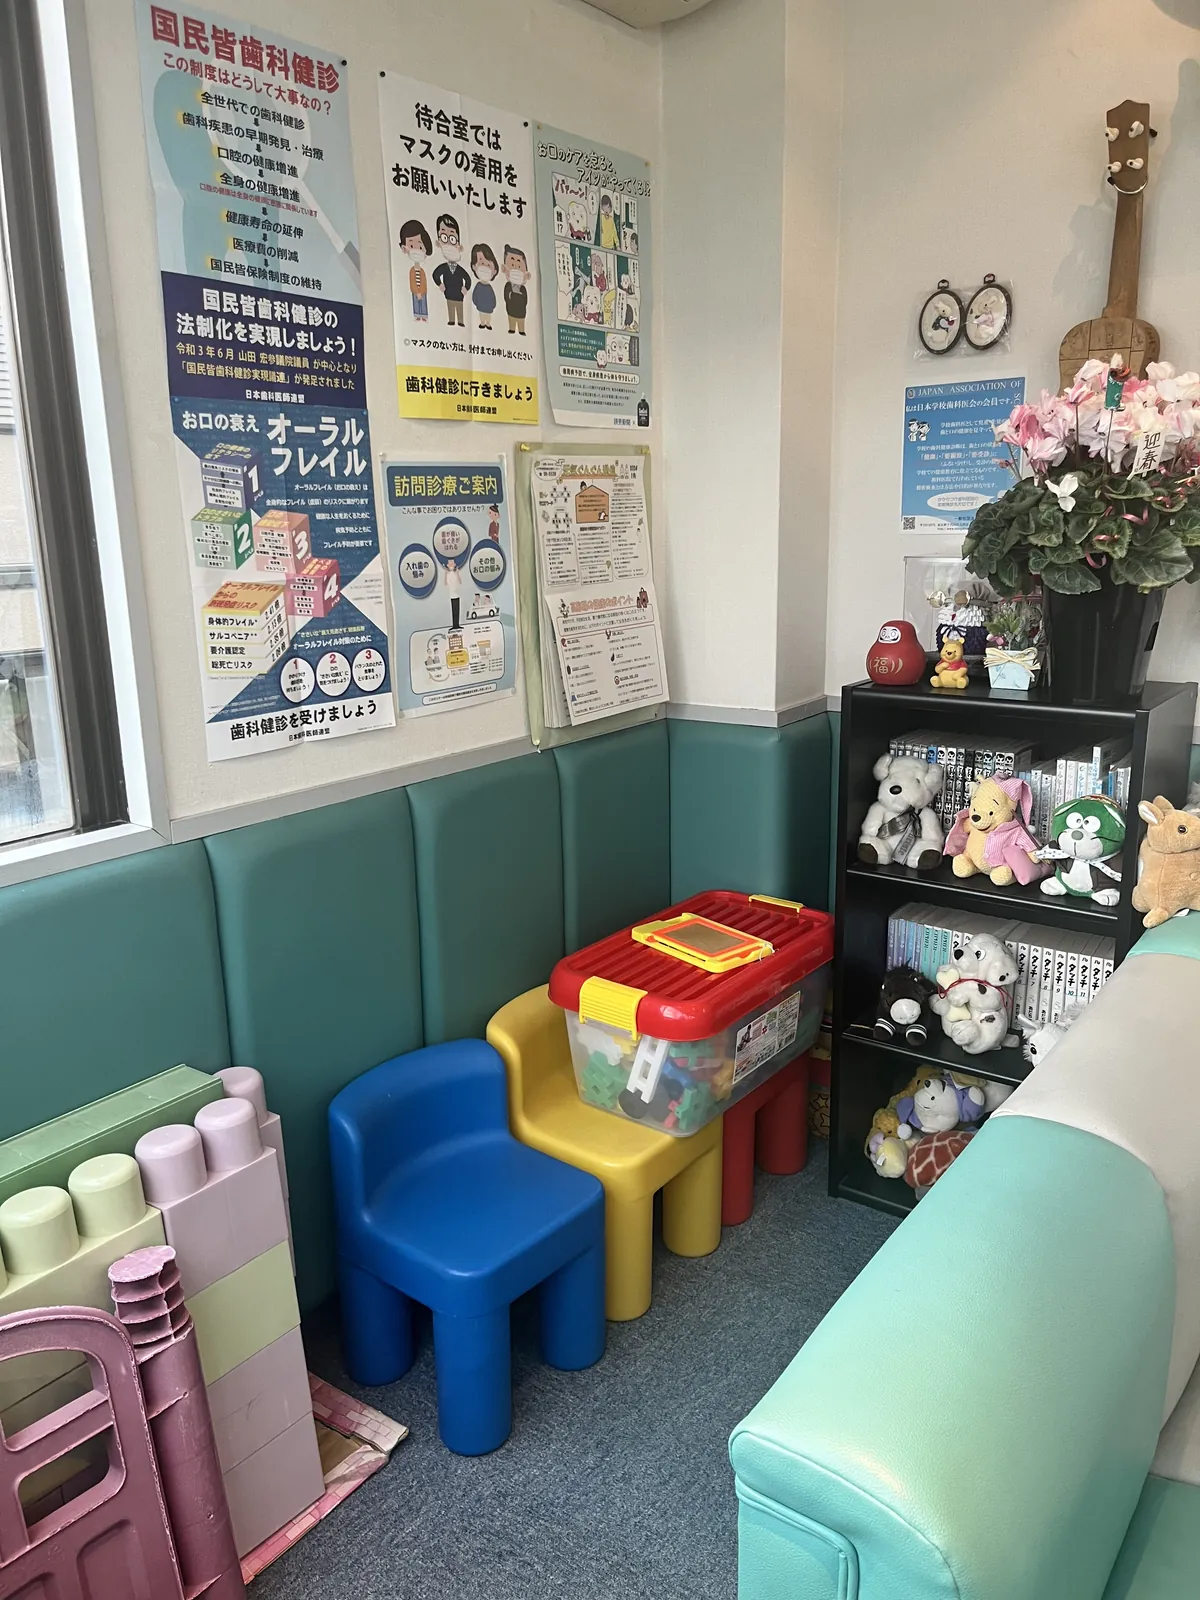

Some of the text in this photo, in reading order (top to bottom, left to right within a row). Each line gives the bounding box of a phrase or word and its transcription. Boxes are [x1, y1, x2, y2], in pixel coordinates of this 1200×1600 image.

[150, 4, 340, 94] 国民皆歯科健診
[163, 52, 331, 115] この制度はどうして大事なの？
[201, 91, 305, 131] 全世代での歯科健診
[182, 112, 325, 161] 歯科疾患の早期発見・治療
[414, 102, 502, 151] 待合室では
[217, 147, 299, 178] 口腔の健康増進
[399, 134, 518, 188] マスクの着用を
[220, 172, 301, 202] 全身の健康増進
[392, 163, 527, 219] お願いいたします
[225, 210, 304, 239] 健康寿命の延伸
[232, 237, 299, 263] 医療費の削減
[210, 258, 322, 291] 国民皆保険制度の維持
[202, 288, 338, 329] 国民皆歯科健診の
[176, 312, 356, 357] 法制化を実現しましょう！
[245, 389, 305, 404] 日本歯科医師連盟
[405, 376, 533, 402] 歯科健診に行きましょう
[917, 380, 1023, 397] JAPAN ASSOCIATION OF
[905, 396, 1013, 413] 私は日本学校歯科医会の会員です。
[182, 411, 260, 434] お口の衰え
[267, 413, 365, 447] オーラル
[270, 446, 367, 478] フレイル
[1139, 431, 1161, 470] 迎春
[394, 474, 498, 498] 訪問診療ご案内
[406, 561, 429, 571] 入れ歯の
[478, 557, 495, 565] その他
[215, 590, 238, 598] からの
[222, 582, 281, 592] オーラルフレイル
[210, 645, 246, 656] 要介護認定
[329, 653, 337, 664] 2
[365, 650, 372, 660] 3
[211, 660, 253, 669] 総死亡リスク
[293, 659, 299, 670] 1
[873, 656, 889, 674] 福
[229, 699, 377, 740] 歯科健診を受けましょう
[1018, 953, 1027, 976] タッチ
[1030, 955, 1039, 978] タッチ
[1042, 959, 1052, 982] タッチ
[1055, 962, 1064, 984] タッチ
[1067, 964, 1076, 987] タッチ
[1079, 965, 1088, 988] タッチ
[1091, 967, 1101, 991] タッチ
